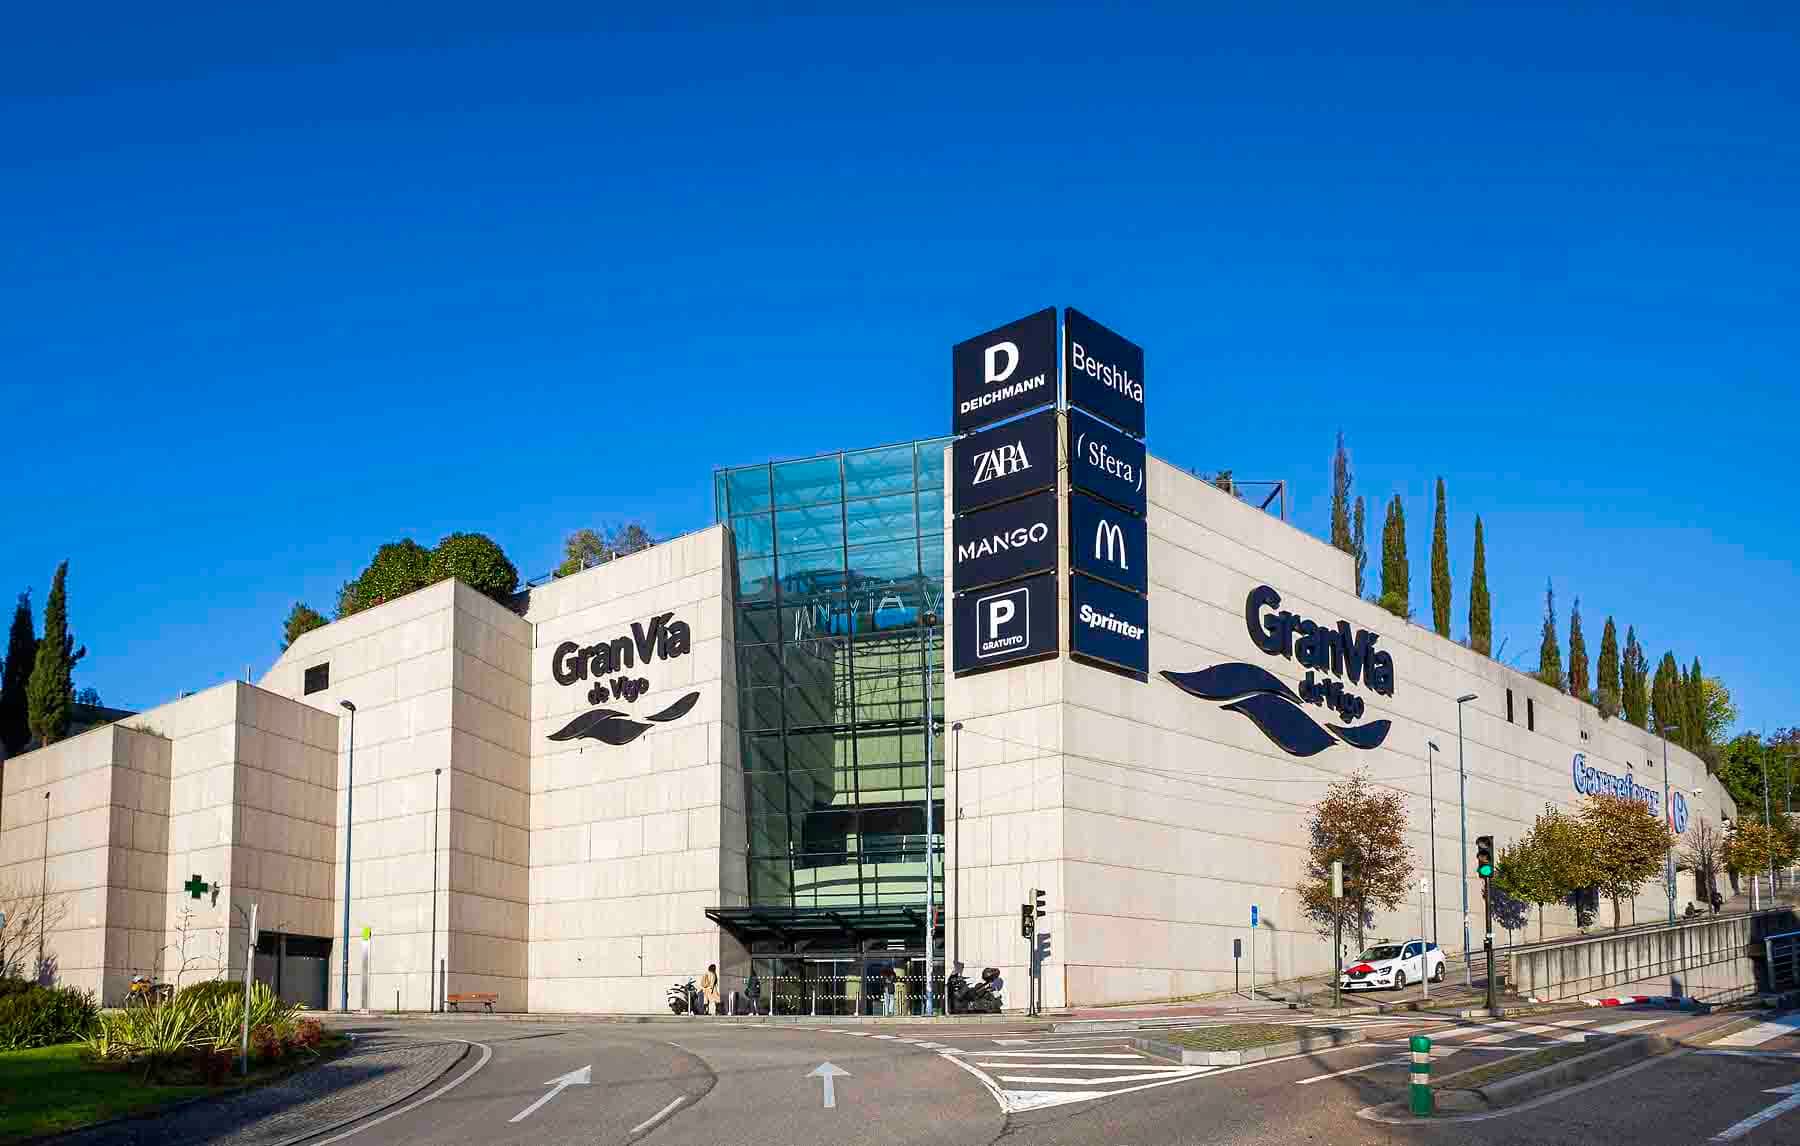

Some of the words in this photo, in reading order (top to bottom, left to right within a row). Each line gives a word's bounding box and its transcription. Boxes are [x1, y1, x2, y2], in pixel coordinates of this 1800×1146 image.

[985, 341, 1019, 384] D
[1072, 341, 1143, 403] Bershka
[960, 373, 1045, 414] DEICHMANN
[972, 439, 1033, 485] ZARA
[958, 522, 1048, 564] MANGO
[989, 599, 1015, 639] P
[1079, 603, 1145, 641] Sprinter
[982, 635, 1023, 651] GRATUITO
[587, 681, 611, 706] de
[609, 676, 650, 703] Vigo
[1298, 671, 1325, 707] de
